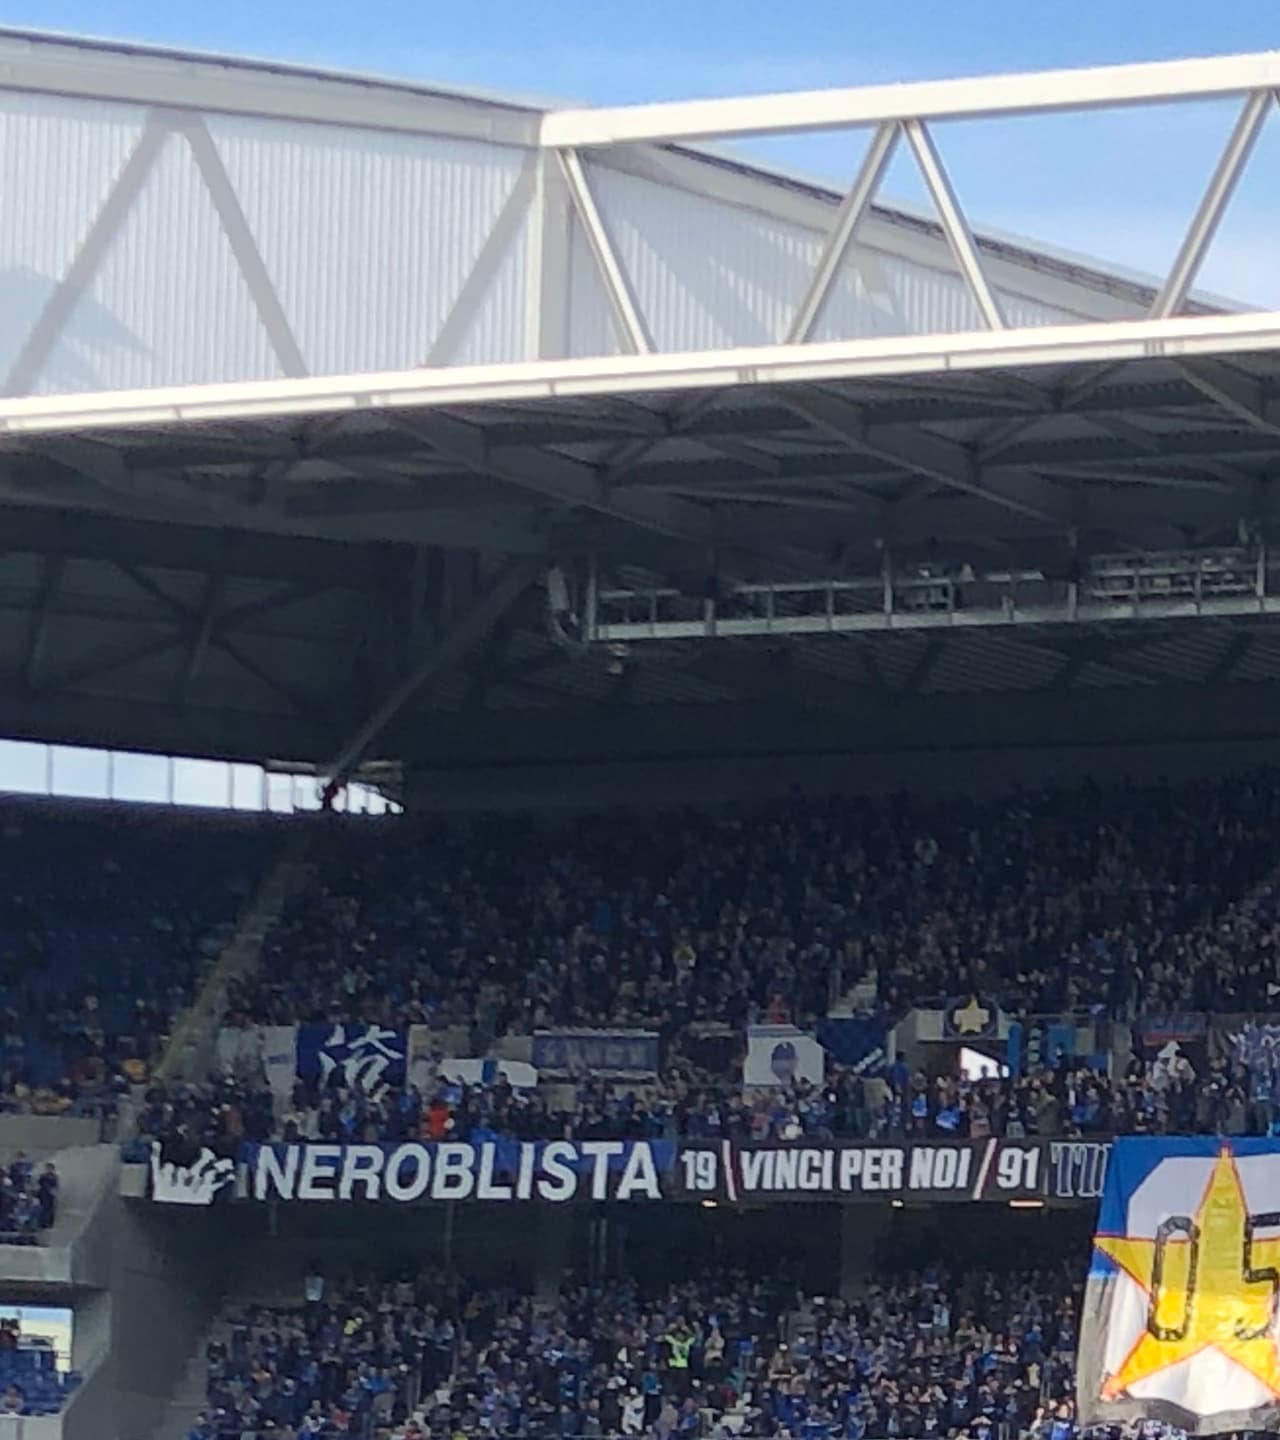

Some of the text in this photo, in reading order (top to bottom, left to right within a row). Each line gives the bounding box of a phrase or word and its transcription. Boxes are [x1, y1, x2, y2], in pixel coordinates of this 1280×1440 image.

[254, 1141, 663, 1202] NEROBLISTA
[681, 1147, 1041, 1191] 19 VINCI PER NOI 91
